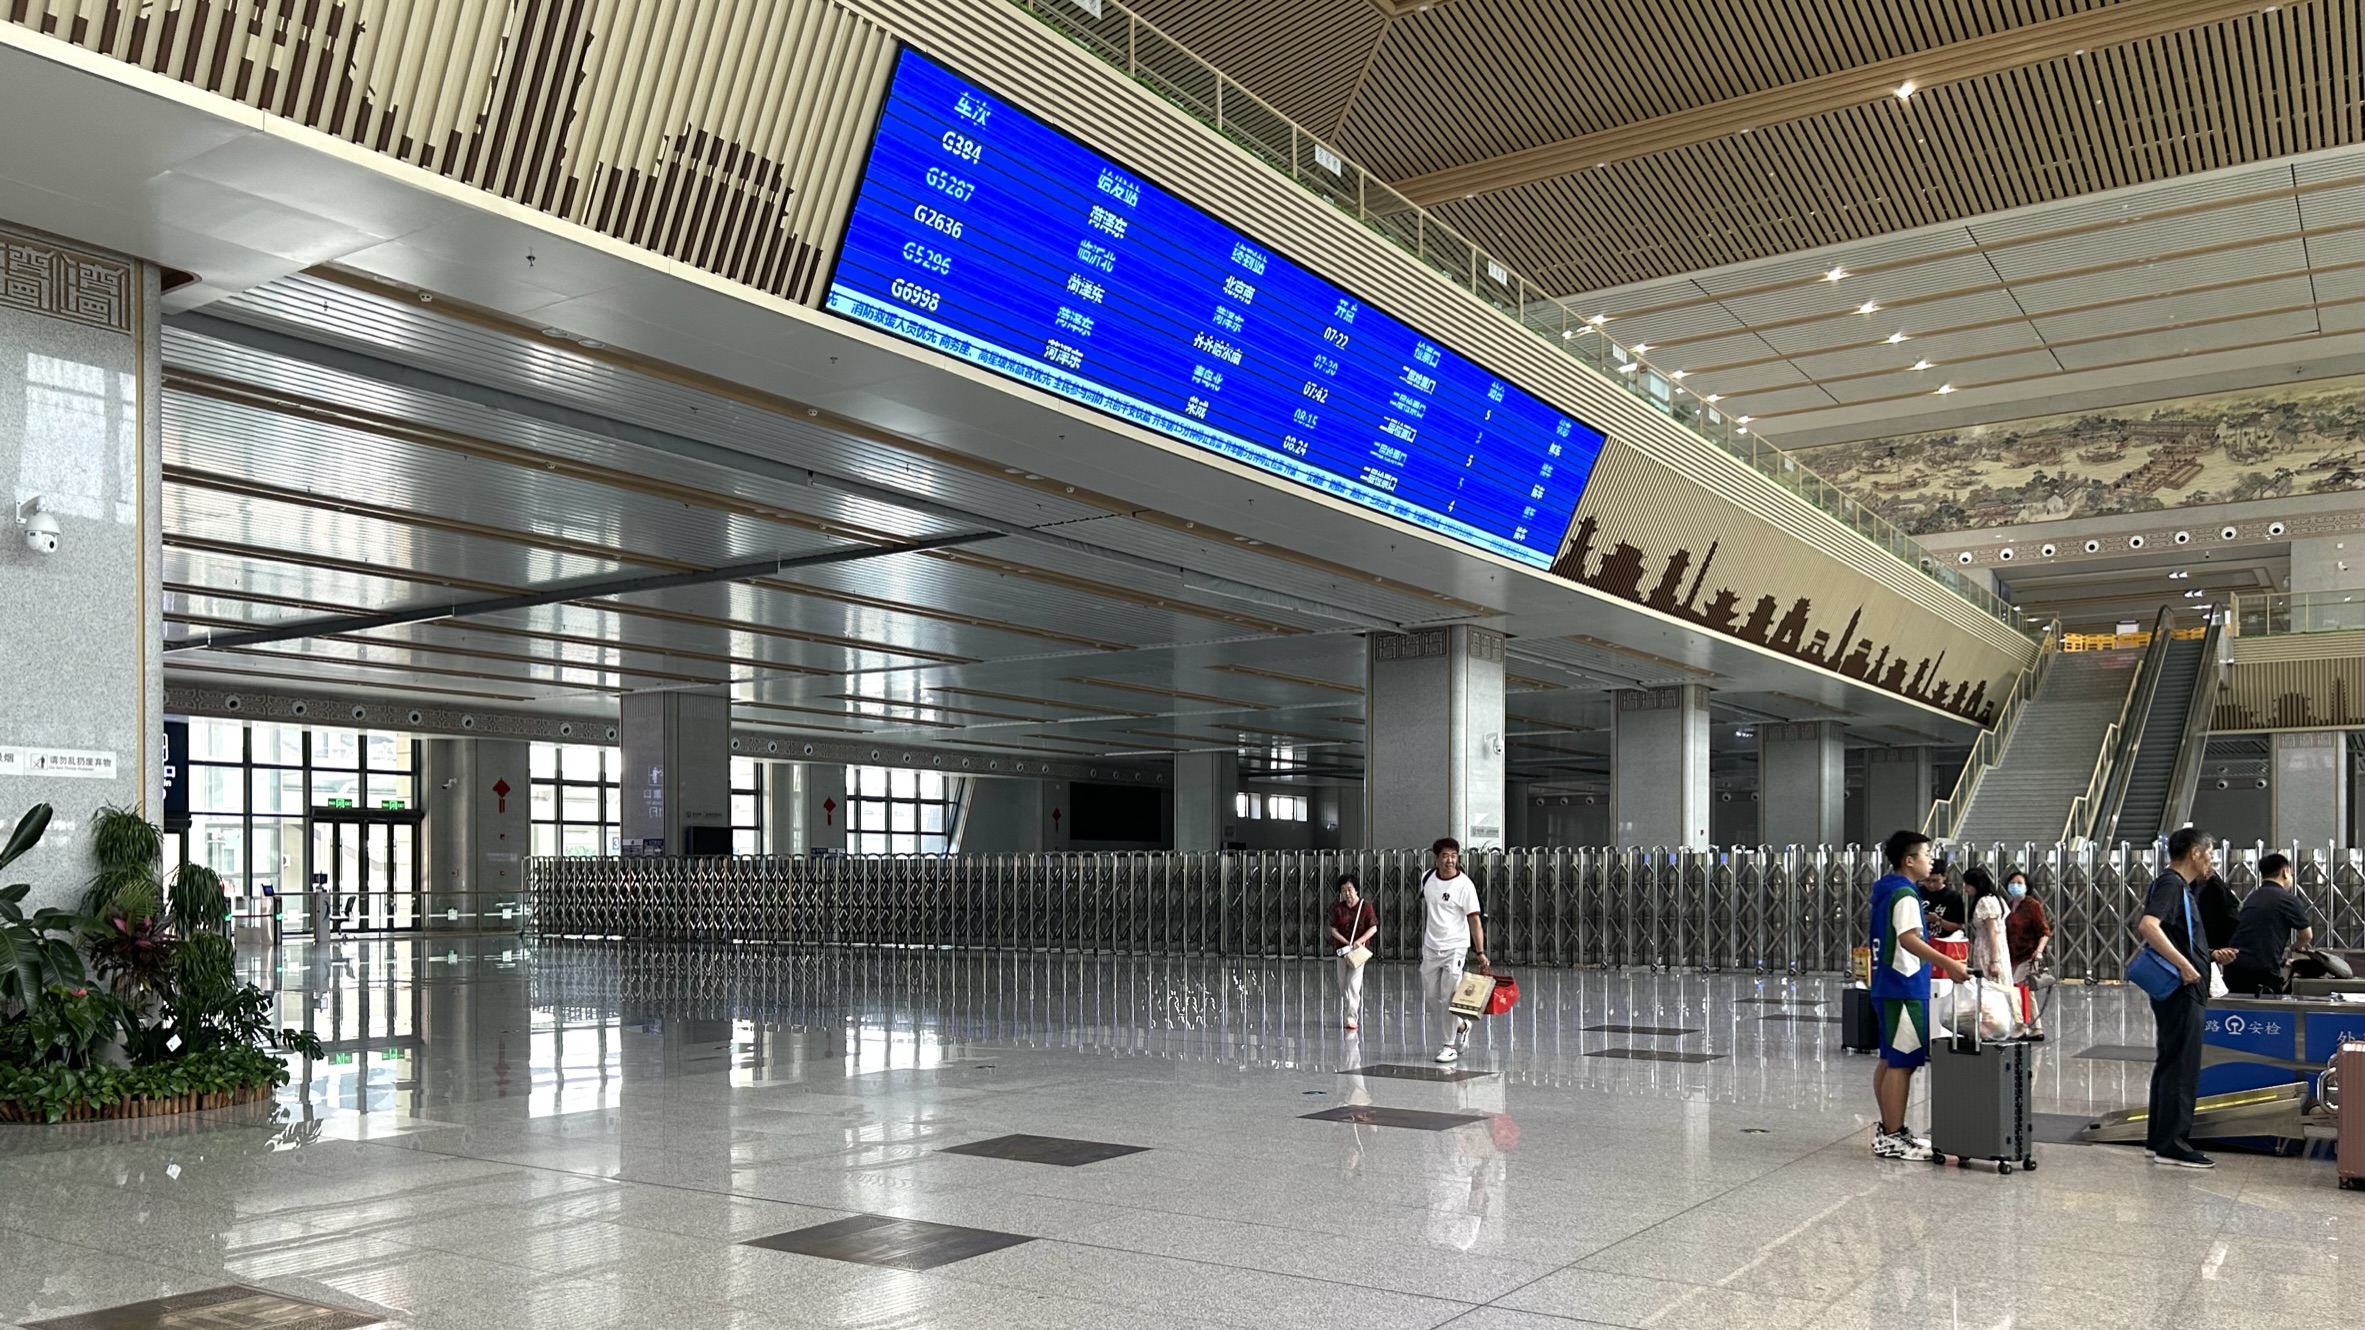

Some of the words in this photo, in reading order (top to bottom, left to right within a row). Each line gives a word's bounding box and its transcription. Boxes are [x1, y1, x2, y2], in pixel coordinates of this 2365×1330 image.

[914, 205, 963, 238] G2636
[1067, 273, 1105, 303] 菏泽东
[1194, 332, 1243, 365] 齐齐哈尔南
[1303, 382, 1328, 403] 07:42
[927, 167, 974, 201] G5287
[1078, 240, 1115, 272] 临沂北
[1213, 306, 1244, 332] 菏泽东
[1314, 355, 1338, 375] 07:30
[943, 131, 981, 164] G384
[1088, 206, 1127, 238] 菏泽东
[1223, 276, 1255, 304] 北京南
[1324, 327, 1348, 350] 07:22
[1484, 409, 1492, 421] 5
[954, 92, 990, 129] 车次
[1097, 168, 1140, 207] 始发站
[1231, 242, 1267, 275] 终到站
[1335, 299, 1357, 323] 开点
[1414, 341, 1440, 368] 检票口
[892, 279, 940, 311] G6998
[1044, 340, 1083, 368] 菏泽东
[1185, 396, 1208, 419] 荣成
[1447, 500, 1456, 513] 4
[903, 242, 951, 274] G5296
[1056, 307, 1094, 336] 菏泽东
[1192, 365, 1223, 391] 青岛北
[1294, 409, 1318, 428] 08:15
[0, 752, 15, 763] 烟
[49, 755, 112, 768] 请勿乱扔废弃物
[2204, 1019, 2221, 1033] 路
[2247, 1021, 2282, 1035] 安检
